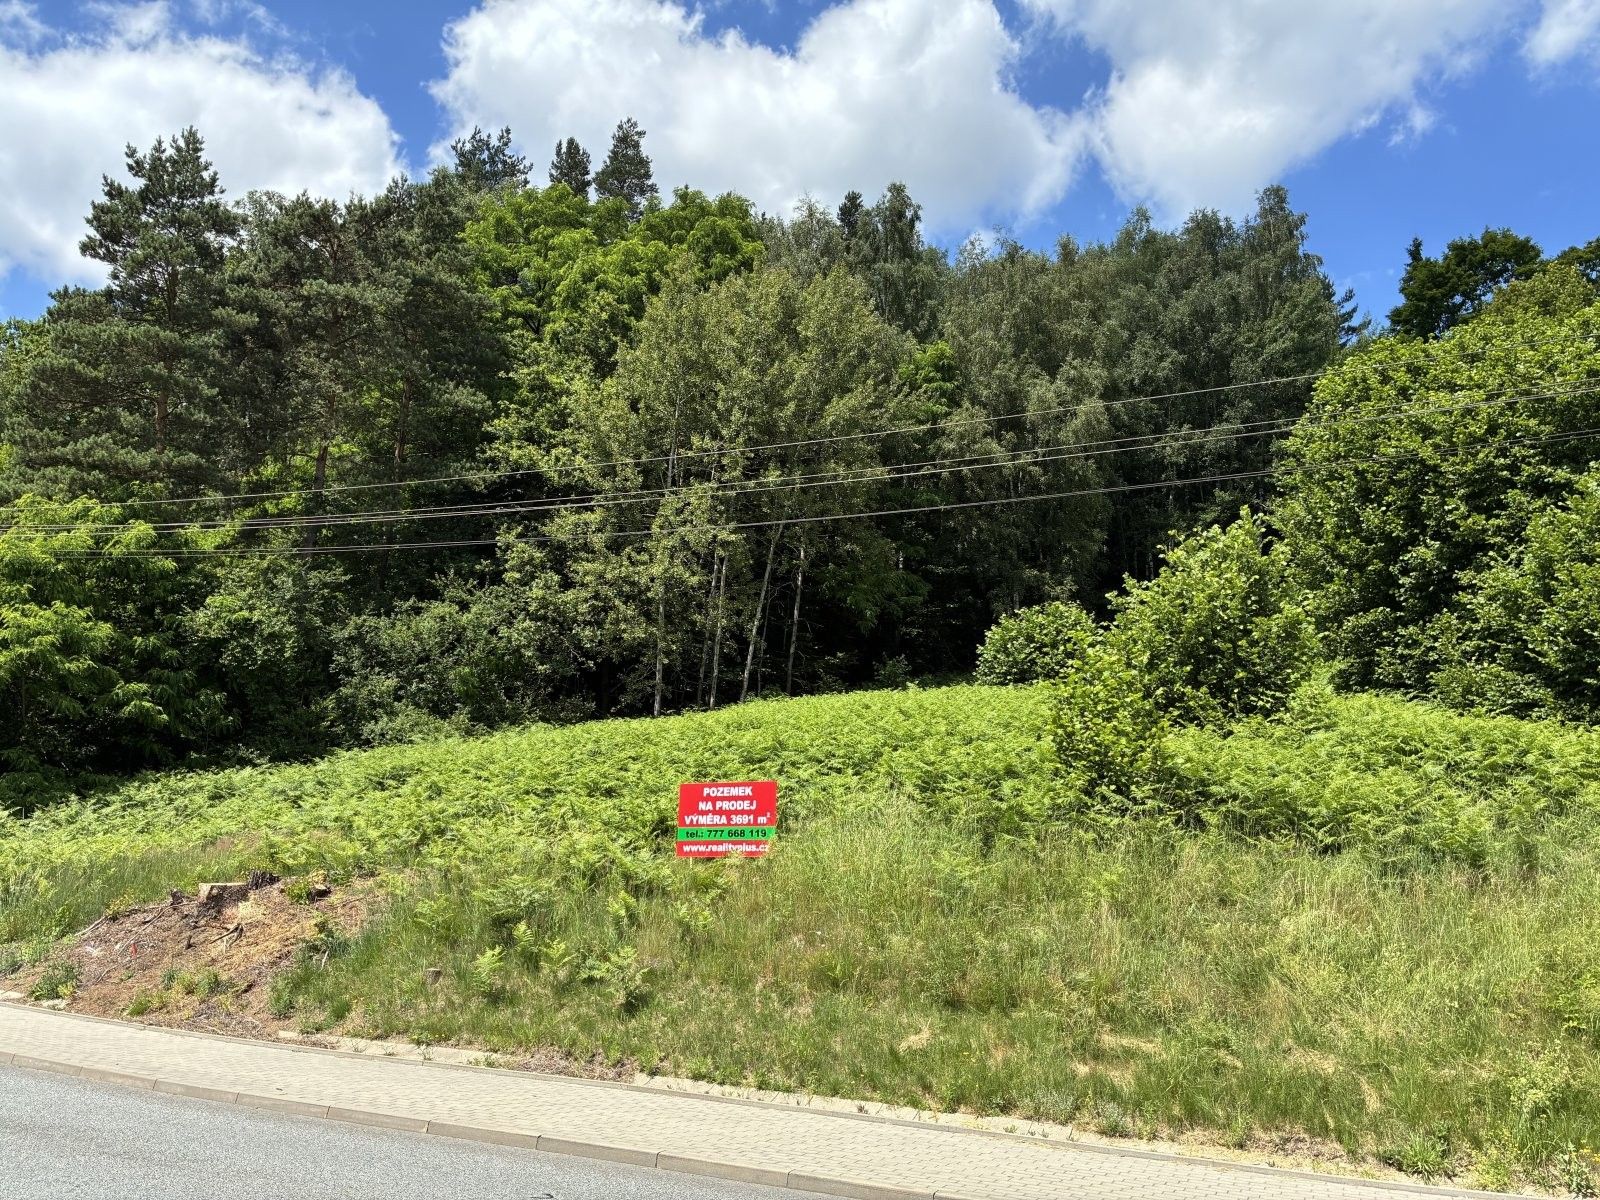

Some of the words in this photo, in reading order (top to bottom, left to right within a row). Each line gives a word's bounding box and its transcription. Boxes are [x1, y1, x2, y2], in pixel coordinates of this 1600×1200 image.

[703, 786, 753, 797] POZEMEK
[698, 801, 713, 811] NA
[716, 800, 757, 810] PRODEJ
[684, 813, 727, 824] VÝMĚRA
[730, 815, 754, 824] 3691
[685, 831, 704, 839] tel.:
[707, 830, 725, 838] 777
[728, 829, 746, 838] 668
[749, 829, 767, 838] 119
